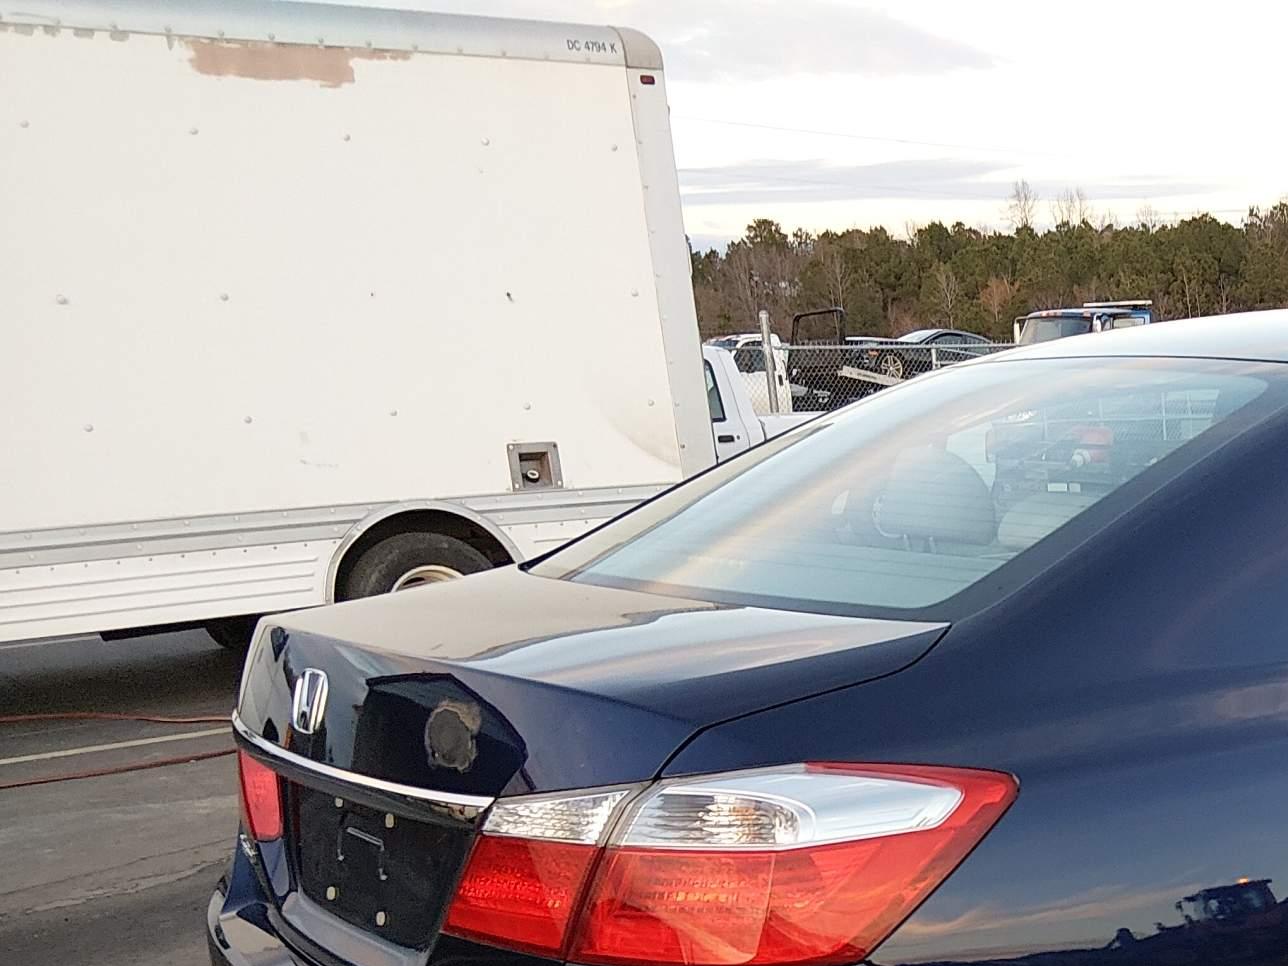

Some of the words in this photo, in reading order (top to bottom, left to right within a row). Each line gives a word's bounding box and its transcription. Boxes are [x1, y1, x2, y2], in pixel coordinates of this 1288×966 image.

[566, 39, 581, 51] DC
[584, 40, 606, 52] 4794
[609, 42, 617, 54] K
